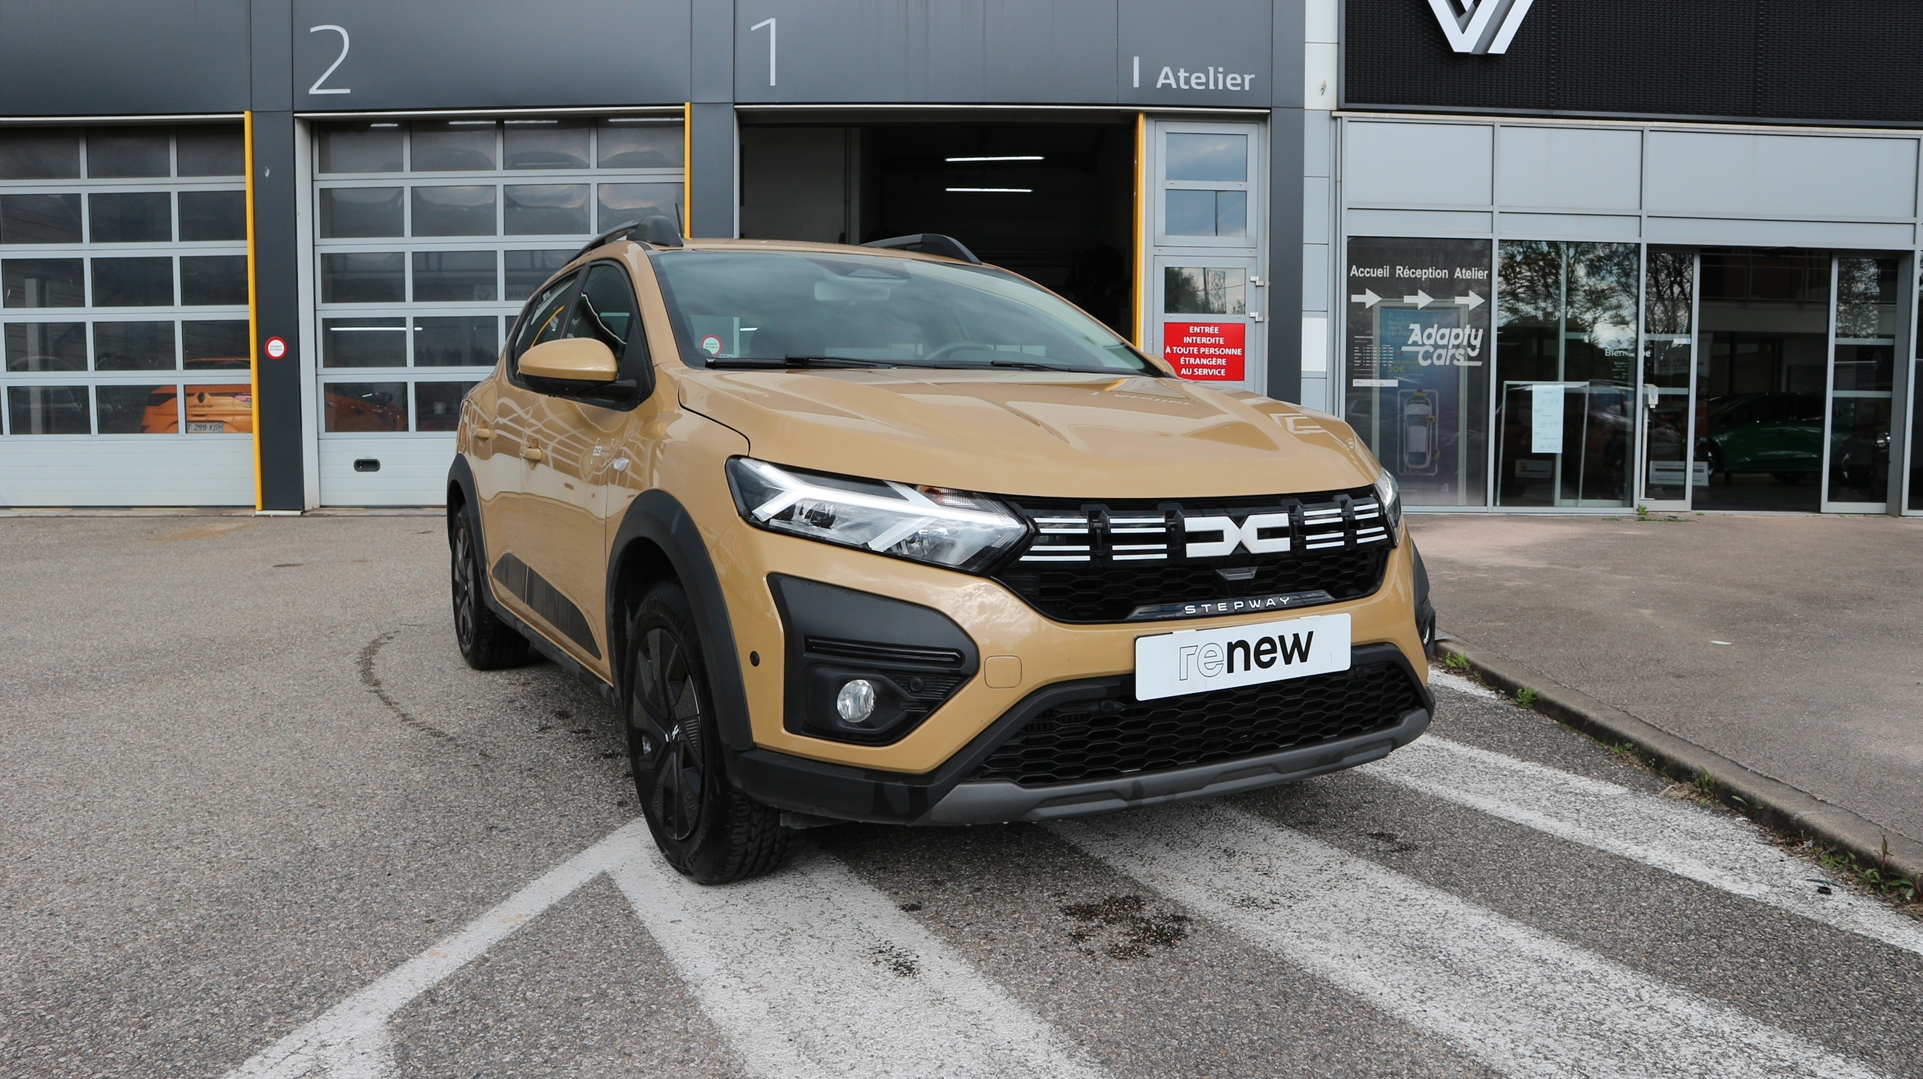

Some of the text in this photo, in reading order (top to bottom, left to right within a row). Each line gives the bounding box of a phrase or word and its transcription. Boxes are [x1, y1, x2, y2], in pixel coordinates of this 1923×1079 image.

[308, 24, 351, 95] 2
[750, 17, 776, 87] 1
[1155, 66, 1256, 91] Atelier
[1349, 264, 1489, 281] Accueil Réception Atelier
[1189, 325, 1220, 334] ENTRÉE
[1183, 336, 1225, 345] INTERDITE
[1407, 323, 1484, 357] Adapty
[1165, 345, 1243, 356] À TOUTE PERSONNE
[1180, 356, 1227, 366] ÉTRANGÈRE
[1180, 367, 1226, 376] AU SERVICE
[1184, 596, 1290, 615] STEPWAY
[1179, 630, 1315, 682] renew
